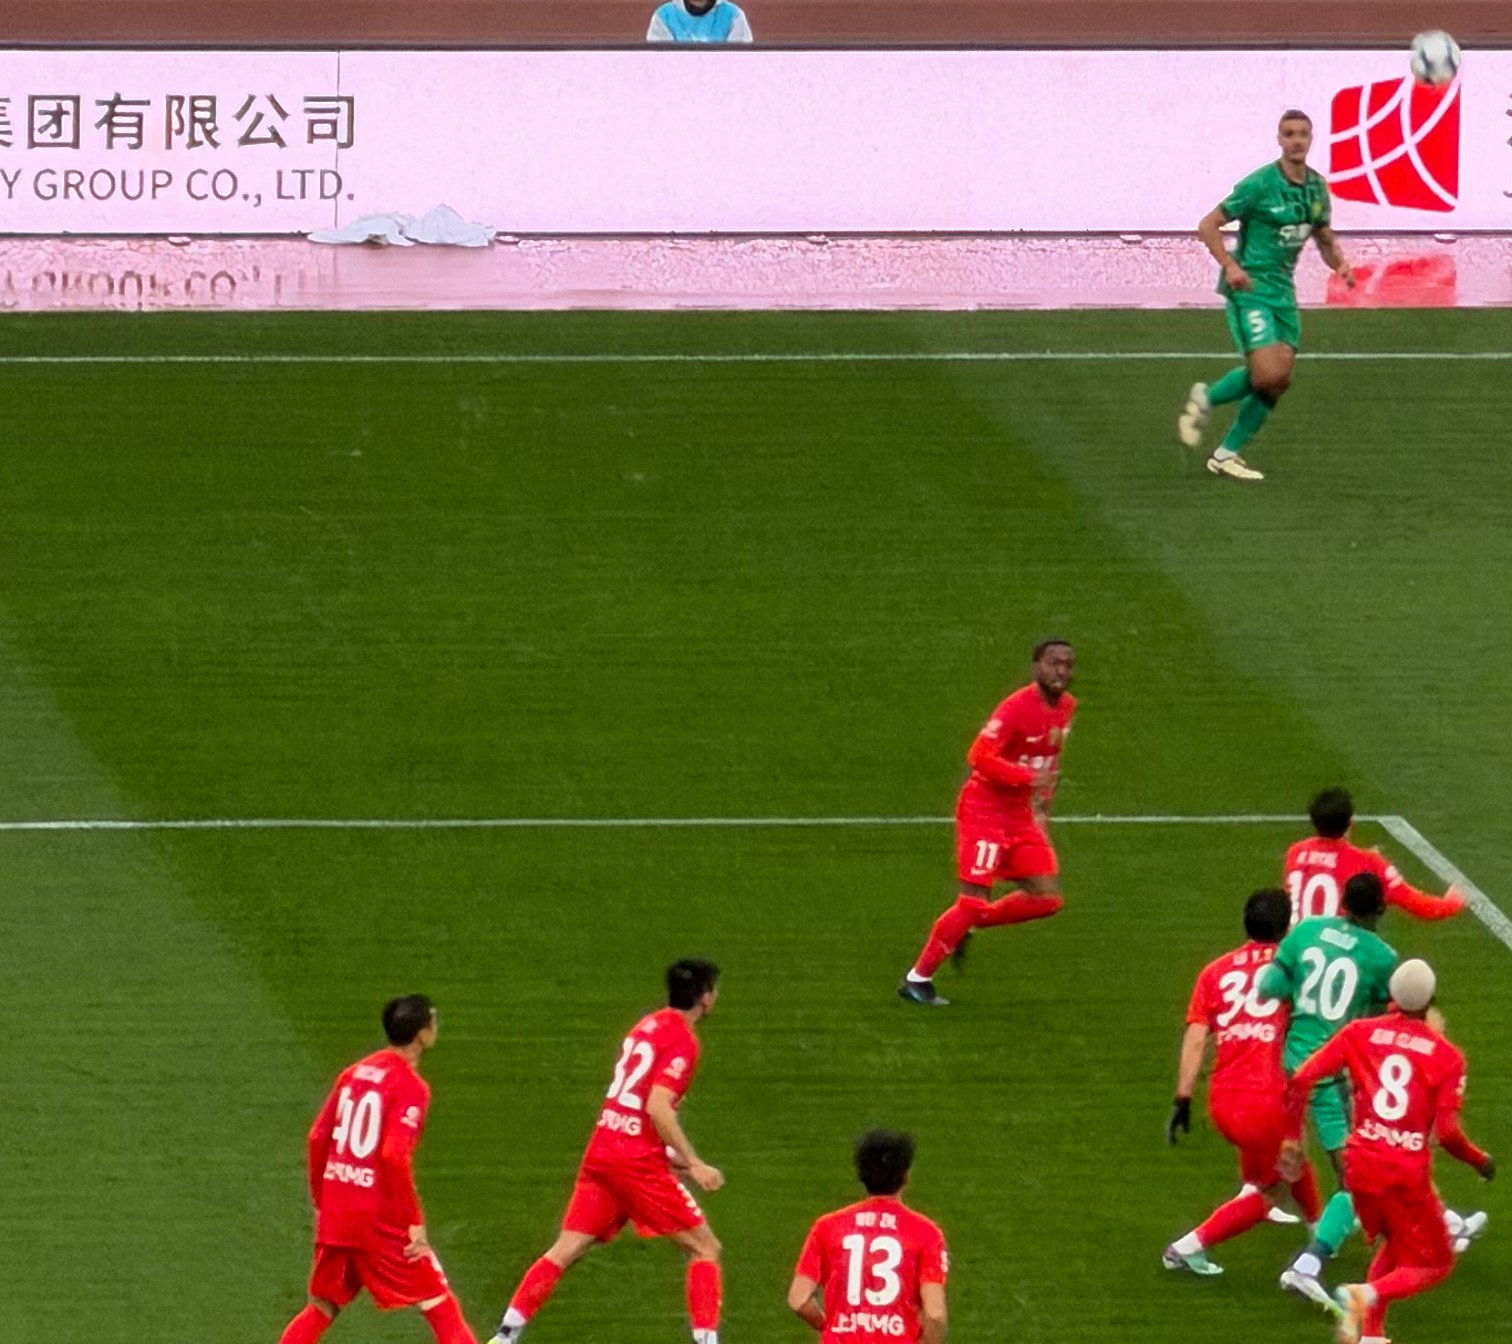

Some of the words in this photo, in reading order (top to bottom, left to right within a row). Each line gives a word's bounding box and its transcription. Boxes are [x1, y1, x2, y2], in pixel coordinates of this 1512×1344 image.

[0, 92, 355, 150] 团有限公司
[33, 168, 173, 201] GROUP
[186, 168, 262, 208] CO.,
[276, 169, 355, 202] LTD.
[1248, 310, 1266, 334] 5
[976, 840, 999, 869] 11
[1297, 946, 1360, 1021] 20
[1372, 1053, 1412, 1121] 8
[332, 1086, 381, 1159] 40
[842, 1233, 903, 1306] 13
